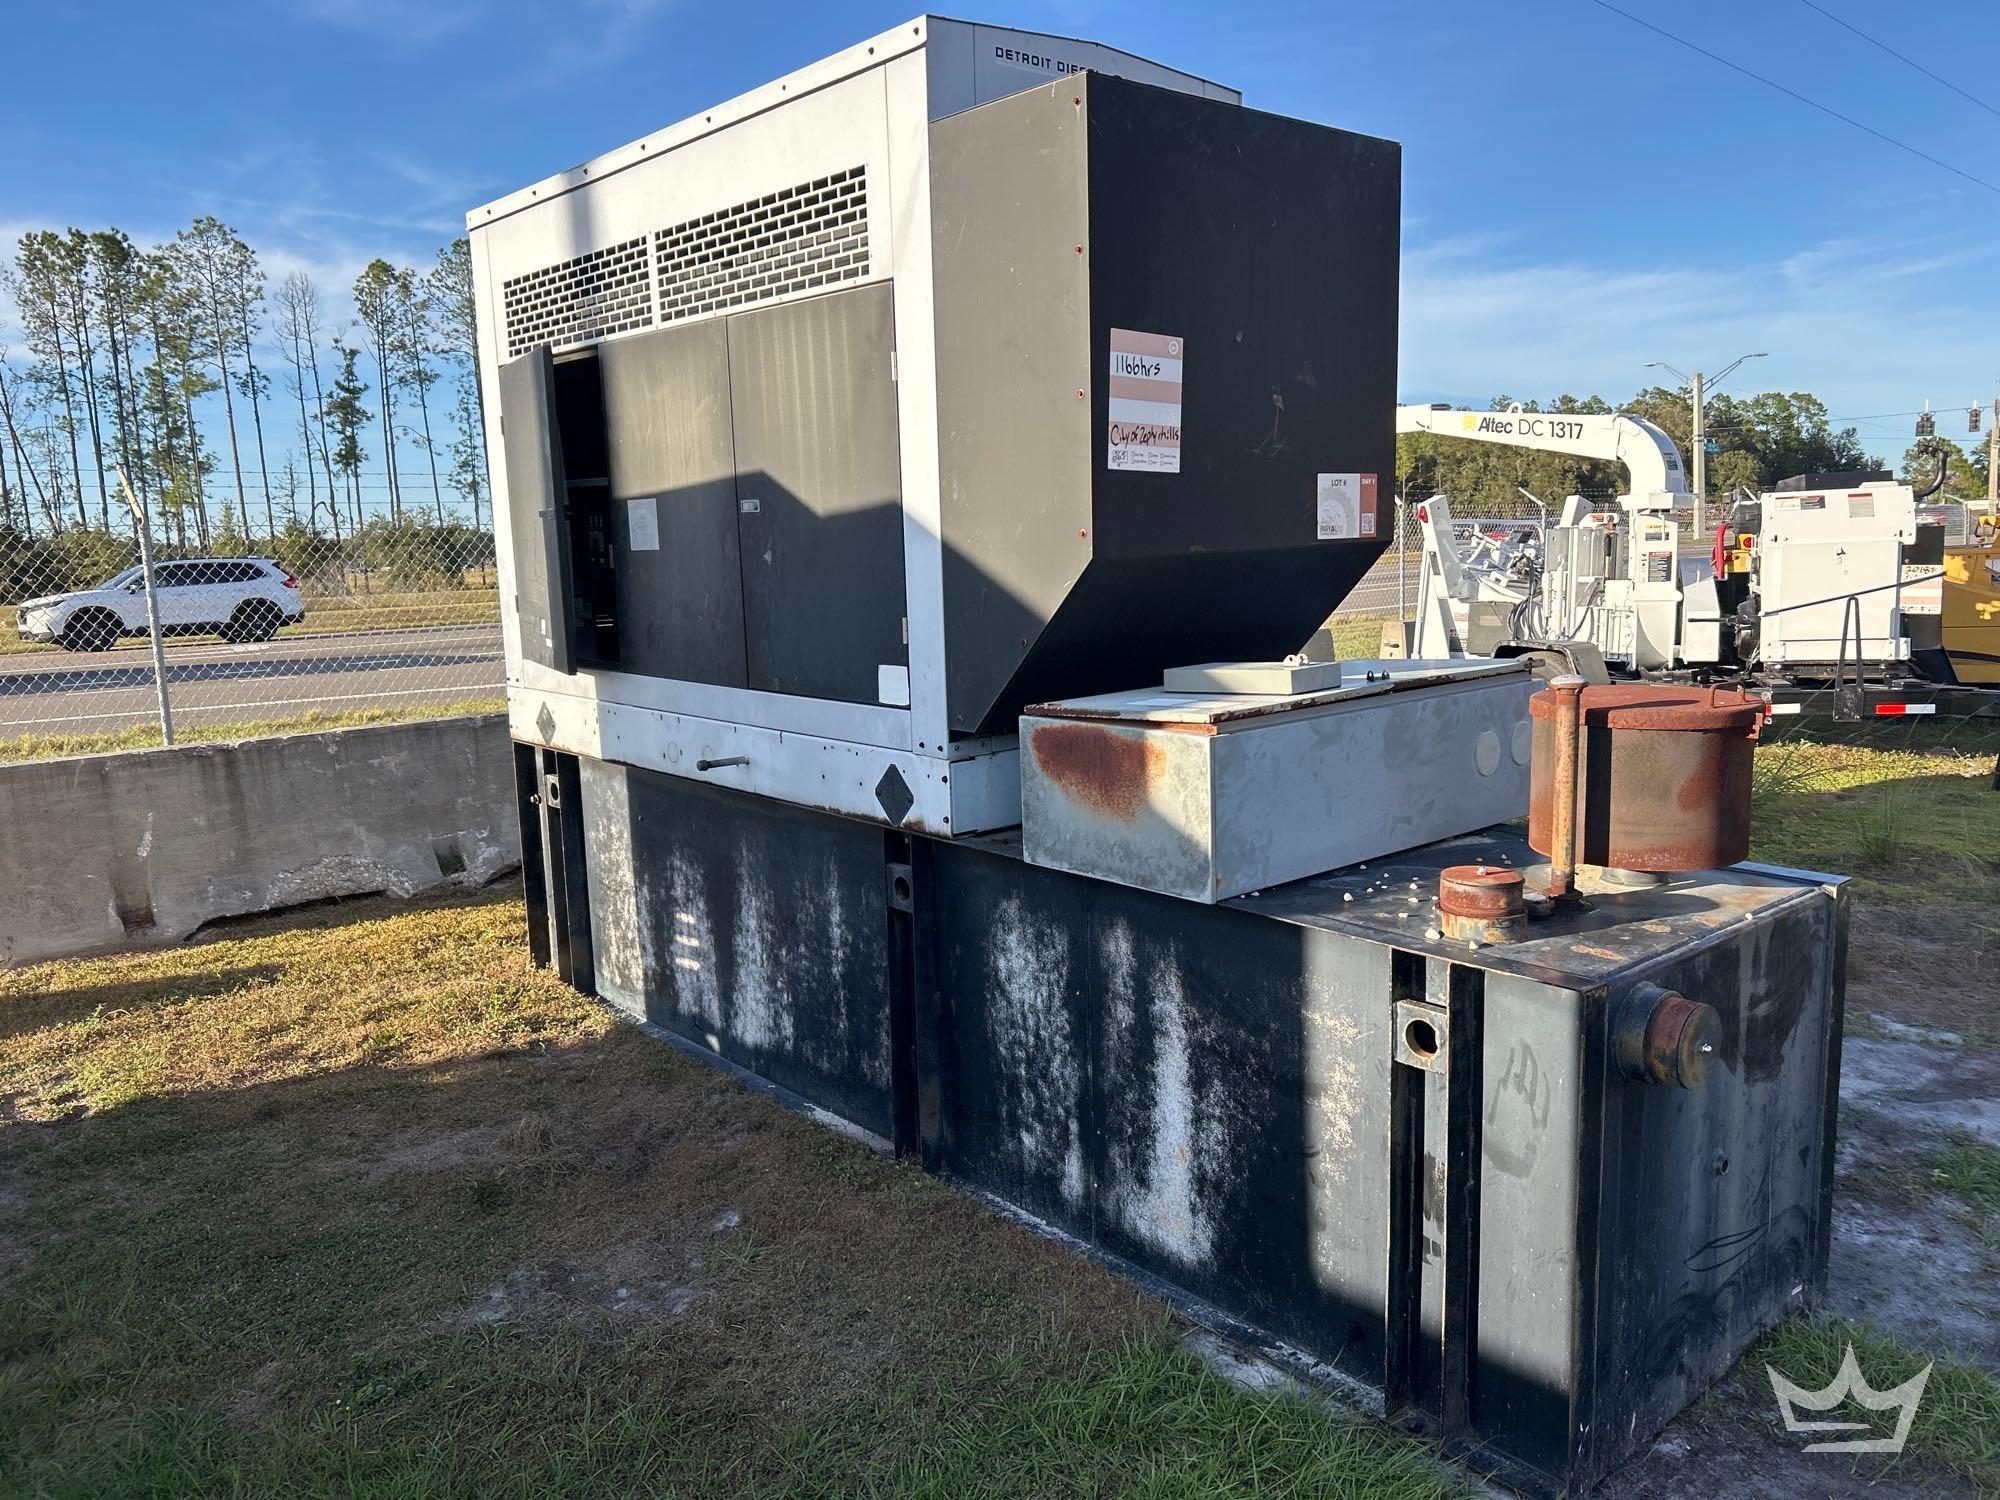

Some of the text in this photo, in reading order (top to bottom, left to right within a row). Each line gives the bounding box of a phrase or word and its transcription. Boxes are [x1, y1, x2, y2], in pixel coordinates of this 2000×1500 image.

[995, 46, 1052, 69] DETROIT
[1478, 416, 1584, 440] Altec DC 1317
[1331, 479, 1342, 487] LOT
